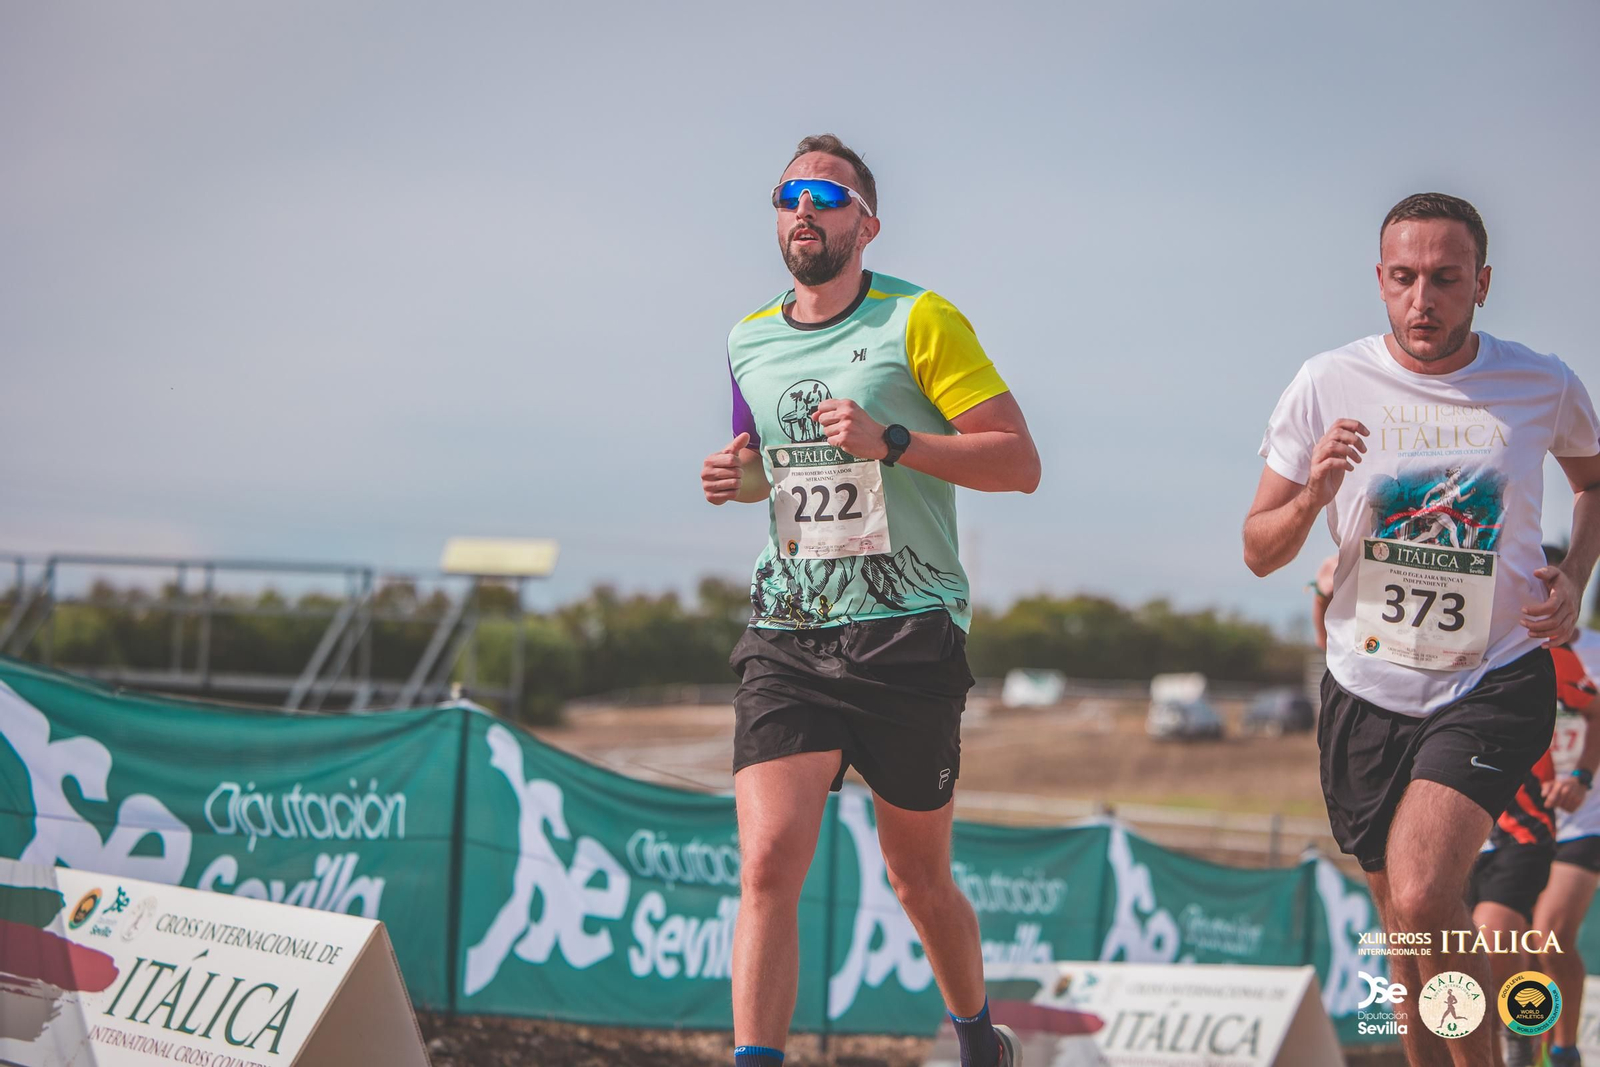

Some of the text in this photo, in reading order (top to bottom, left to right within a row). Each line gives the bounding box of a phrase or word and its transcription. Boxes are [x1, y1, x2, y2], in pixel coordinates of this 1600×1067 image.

[1382, 404, 1491, 424] XLIII CROSS
[1397, 450, 1444, 458] INTERNATIONAL
[791, 483, 863, 522] 222
[1390, 568, 1408, 577] PABLO
[1408, 571, 1423, 579] EGEA
[1397, 548, 1460, 569] ITÁLICA
[1403, 577, 1448, 588] INDEPENDIENTE
[1382, 584, 1466, 632] 373
[156, 913, 344, 965] CROSS INTERNACIONAL DE
[103, 948, 300, 1055] ITÁLICA
[86, 1024, 171, 1059] INTERNATIONAL
[175, 1045, 210, 1067] CROSS
[1104, 1000, 1263, 1057] ITÁLICA
